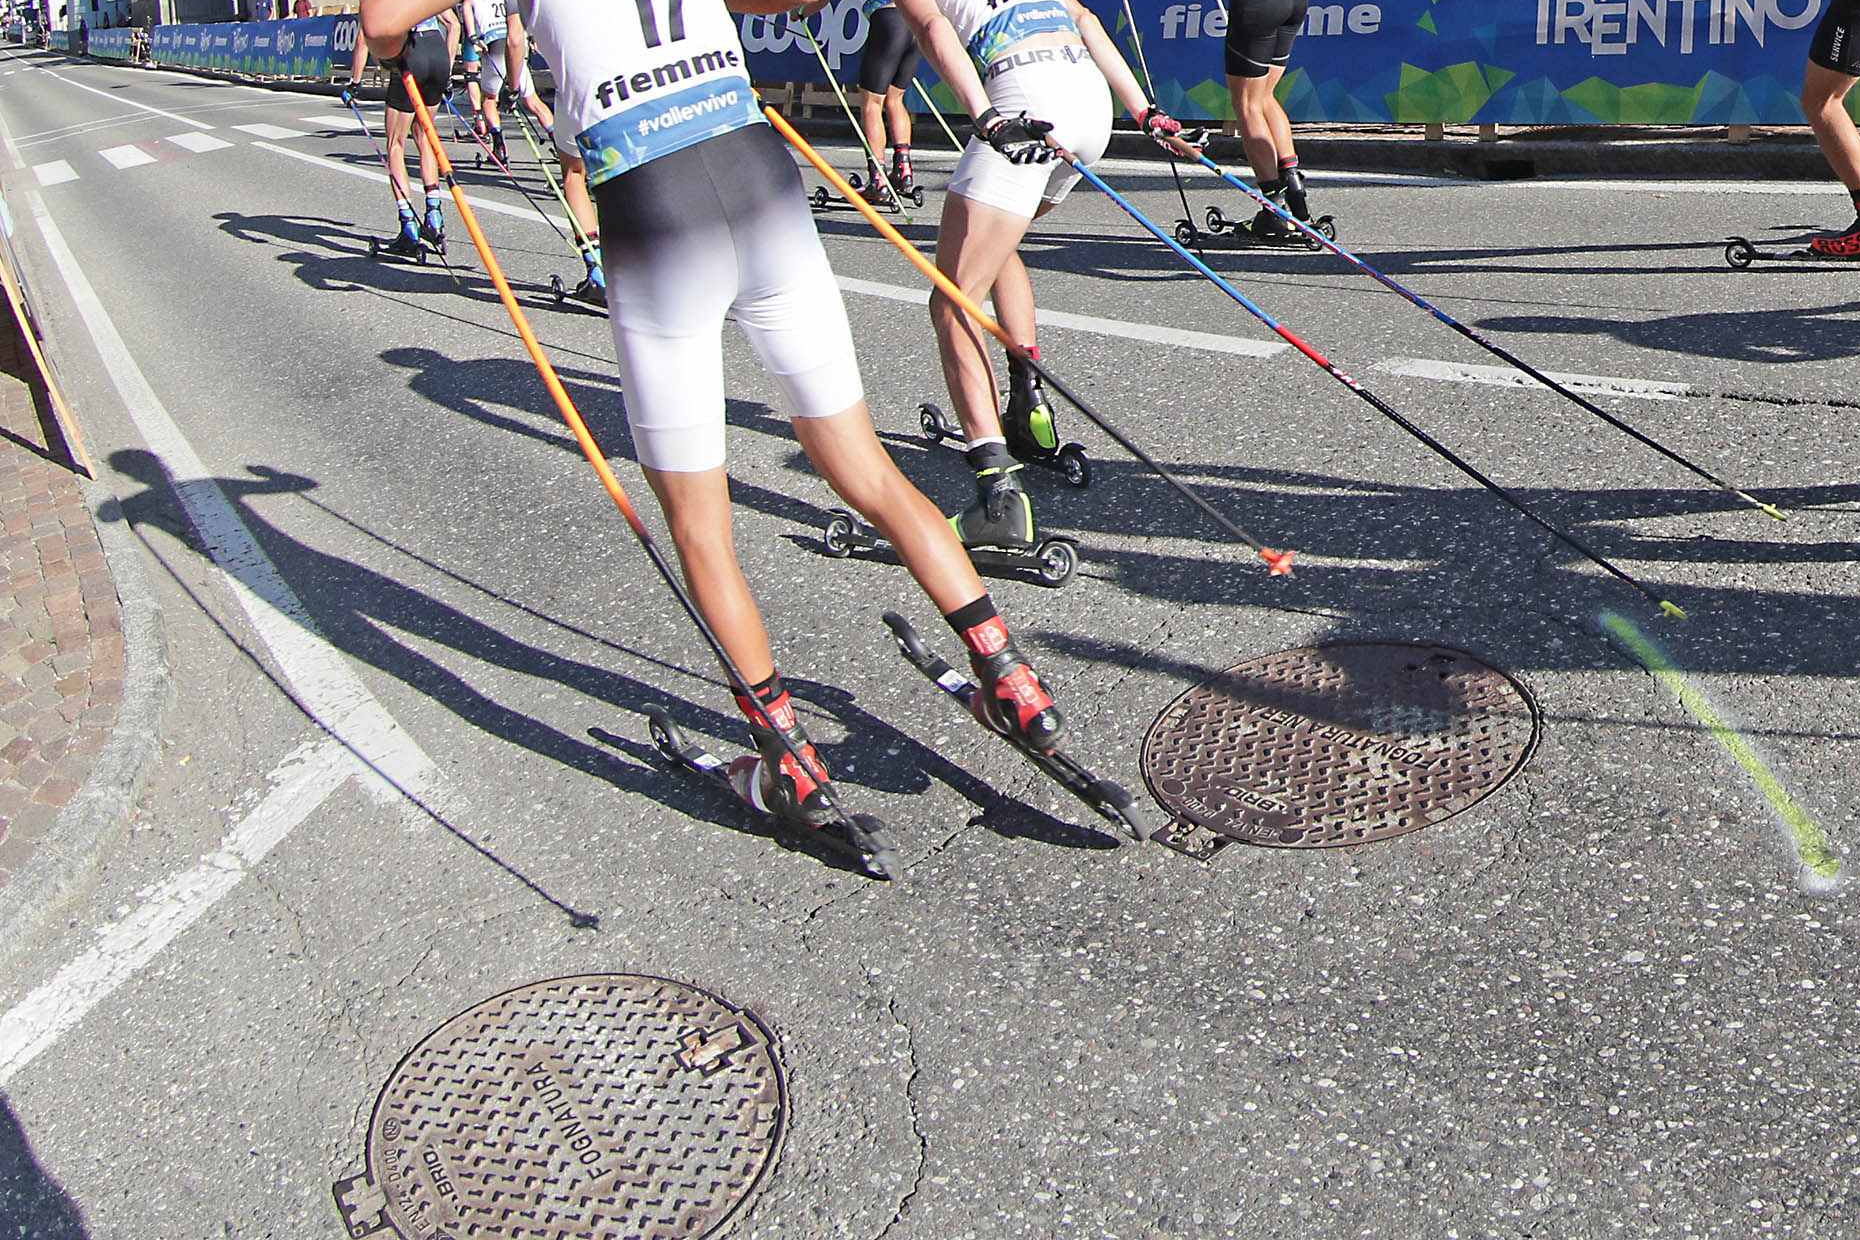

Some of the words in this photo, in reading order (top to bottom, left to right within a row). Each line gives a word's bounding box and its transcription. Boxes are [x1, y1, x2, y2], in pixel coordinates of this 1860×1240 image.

[1159, 3, 1382, 40] fieme
[1830, 25, 1846, 63] SERVICE
[594, 50, 740, 109] fiemme
[637, 89, 739, 137] #vallevviva
[524, 1060, 613, 1181] FOGNATURA
